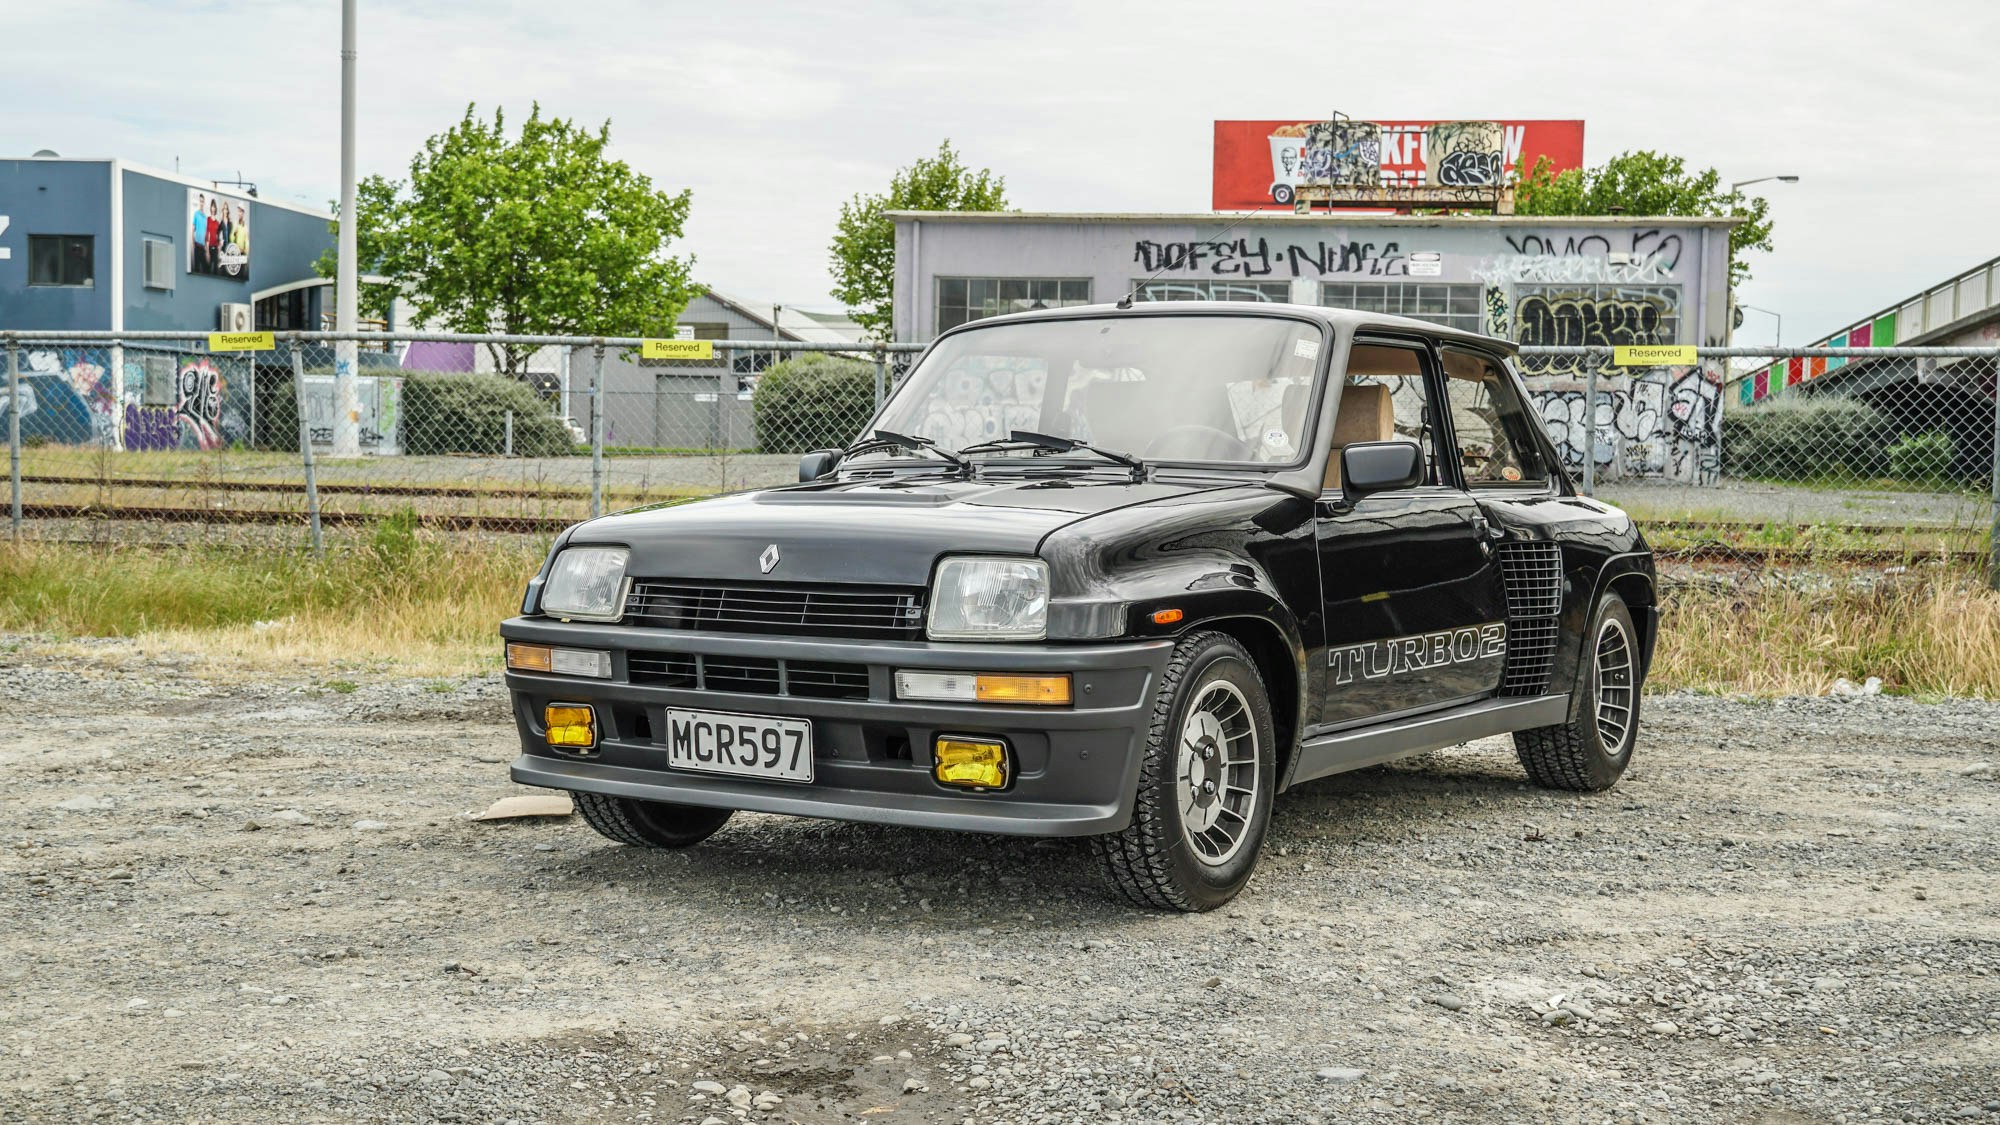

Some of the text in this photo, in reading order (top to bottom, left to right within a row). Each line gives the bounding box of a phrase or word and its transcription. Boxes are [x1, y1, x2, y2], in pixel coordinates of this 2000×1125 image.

[221, 335, 263, 344] Reserved
[655, 342, 700, 352] Reserved
[1629, 348, 1682, 357] Reserved
[672, 719, 804, 771] MCR597
